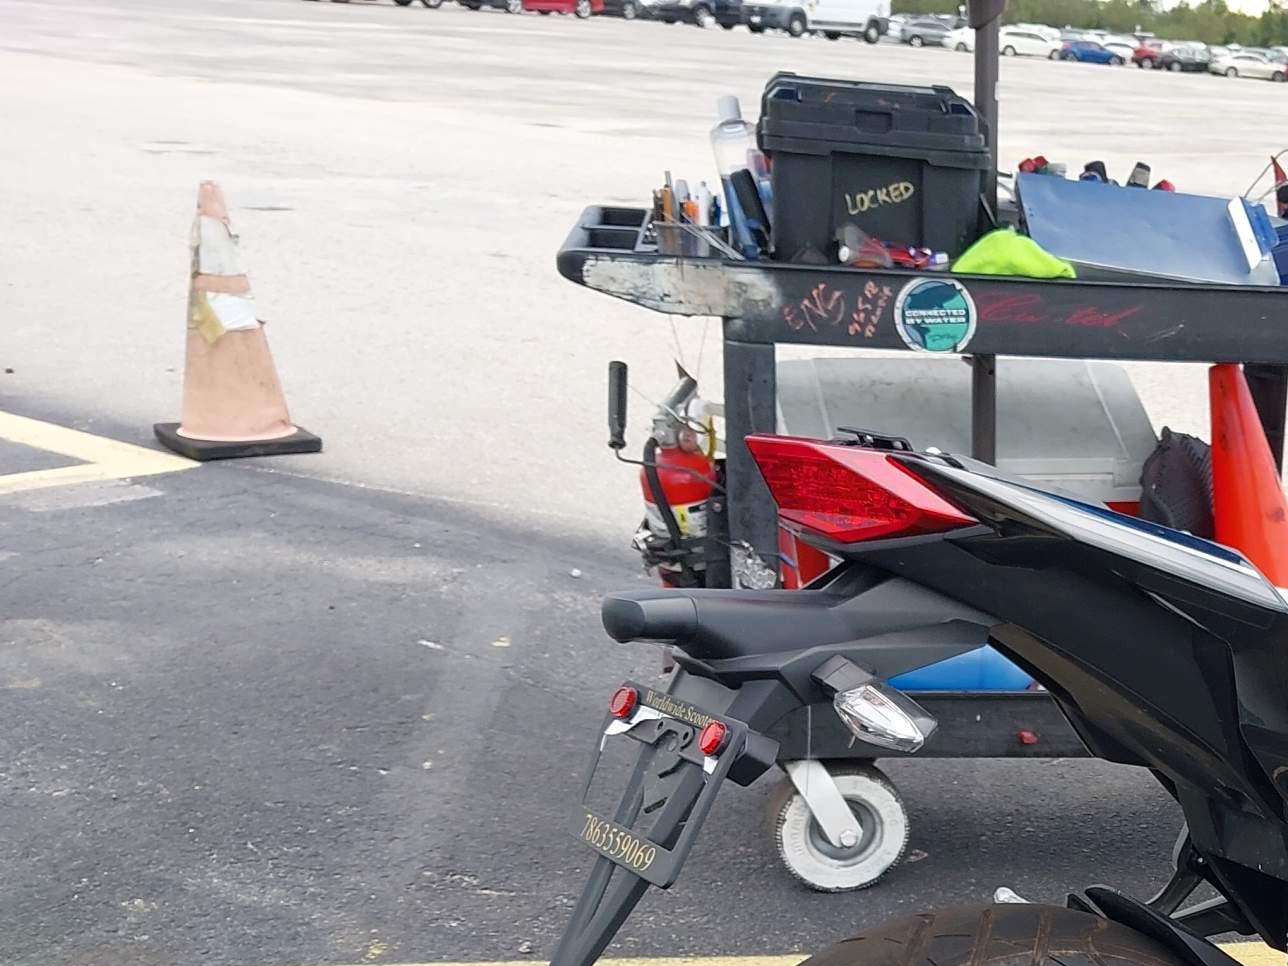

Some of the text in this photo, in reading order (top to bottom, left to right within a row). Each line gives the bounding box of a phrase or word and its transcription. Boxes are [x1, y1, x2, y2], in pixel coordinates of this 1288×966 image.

[844, 181, 915, 215] LOCKED
[646, 689, 685, 717] Worldwide
[580, 813, 657, 872] 7863559069
